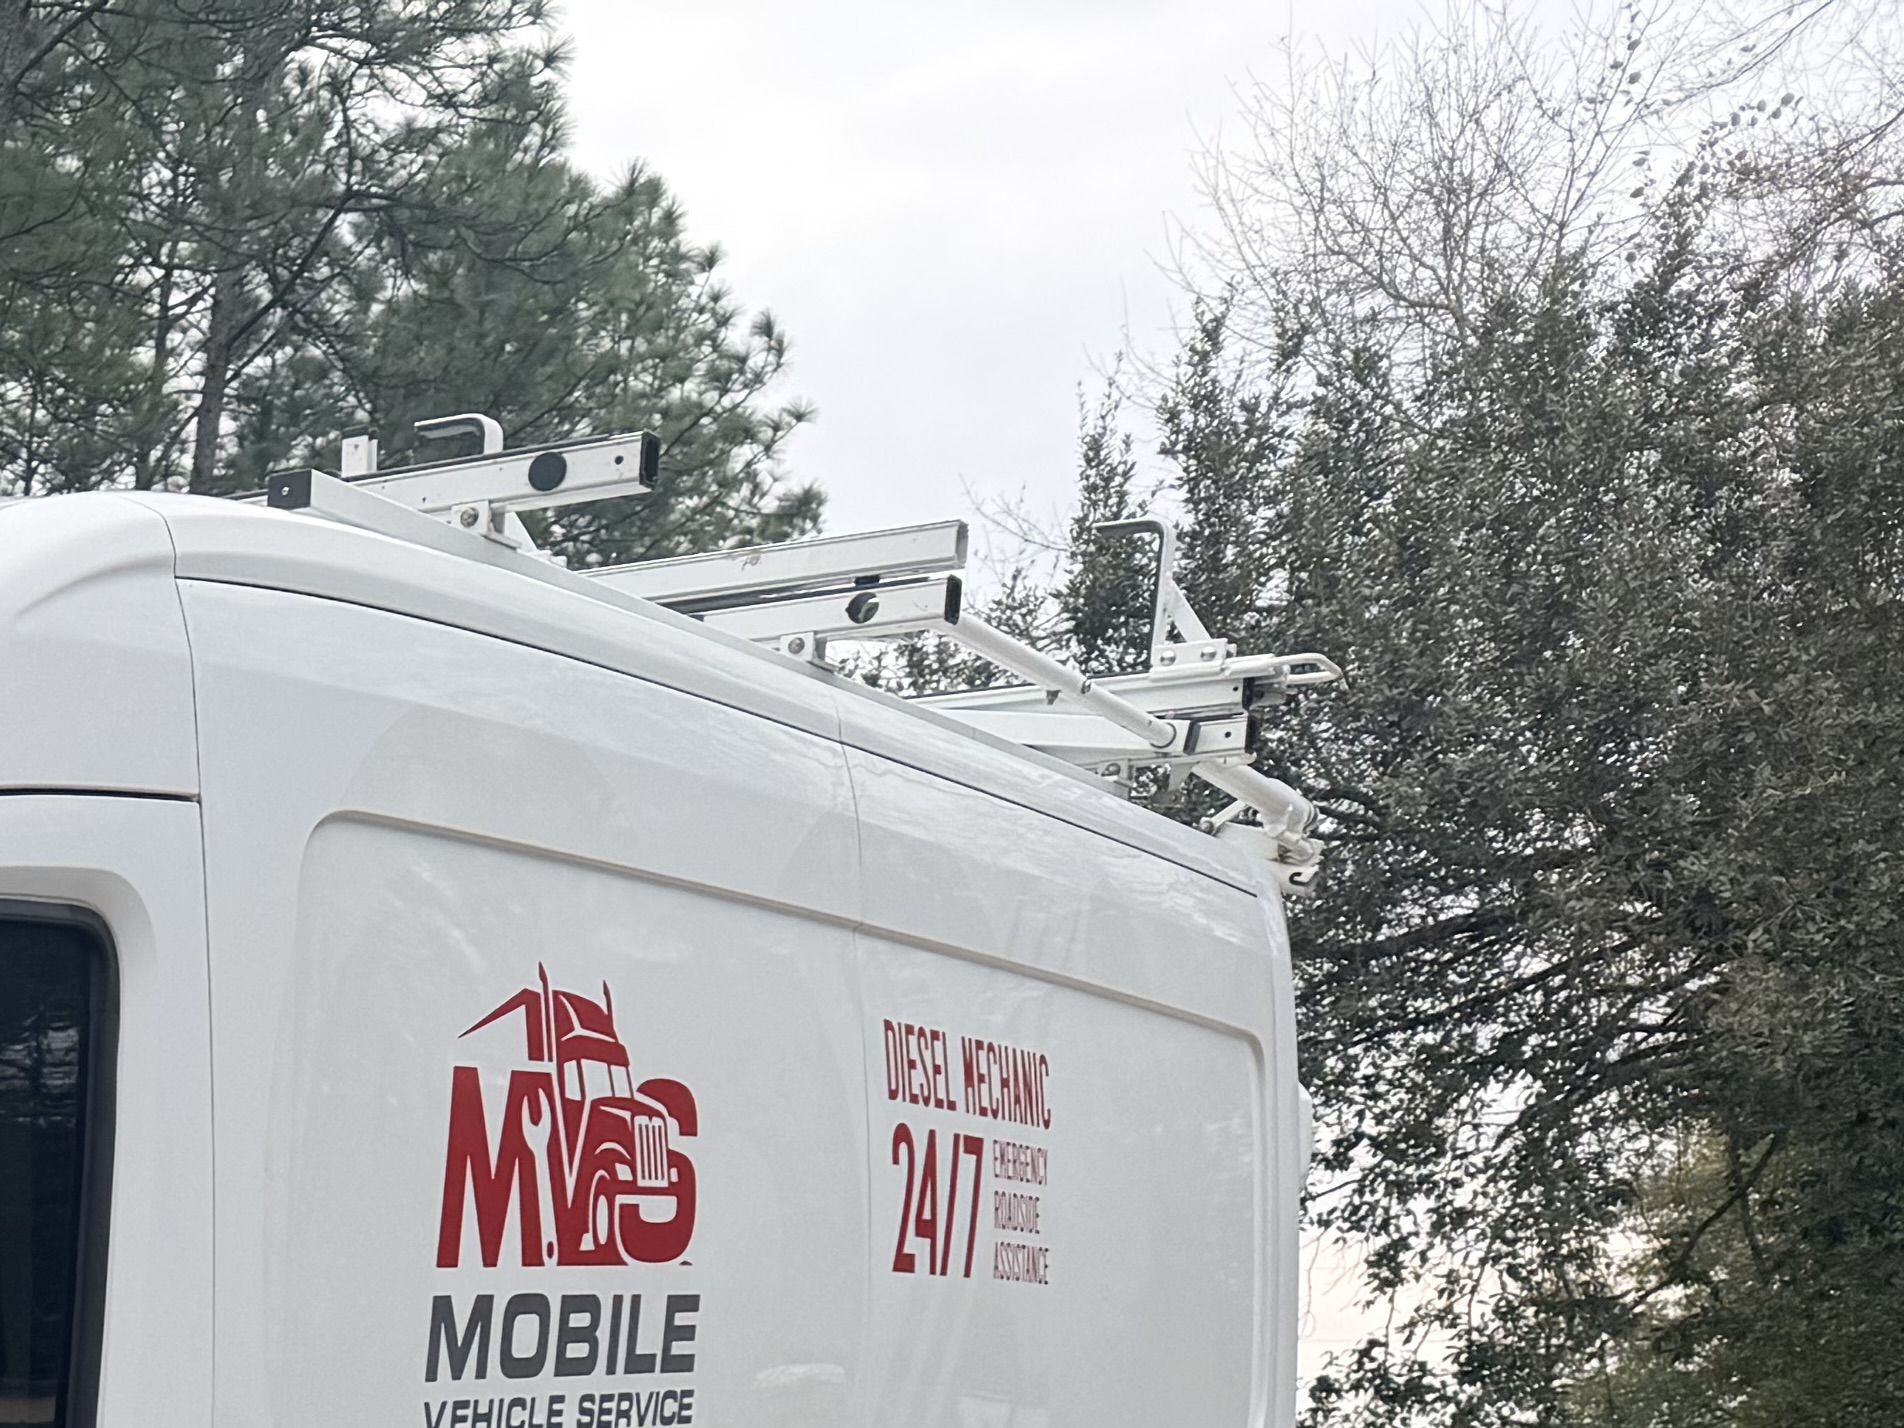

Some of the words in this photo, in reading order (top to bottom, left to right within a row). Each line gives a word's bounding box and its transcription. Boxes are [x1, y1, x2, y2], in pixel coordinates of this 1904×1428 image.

[883, 1019, 957, 1111] DIESEL
[961, 1036, 1051, 1130] MECHANIC
[892, 1122, 984, 1278] 24/7
[424, 1292, 701, 1382] MOBILE
